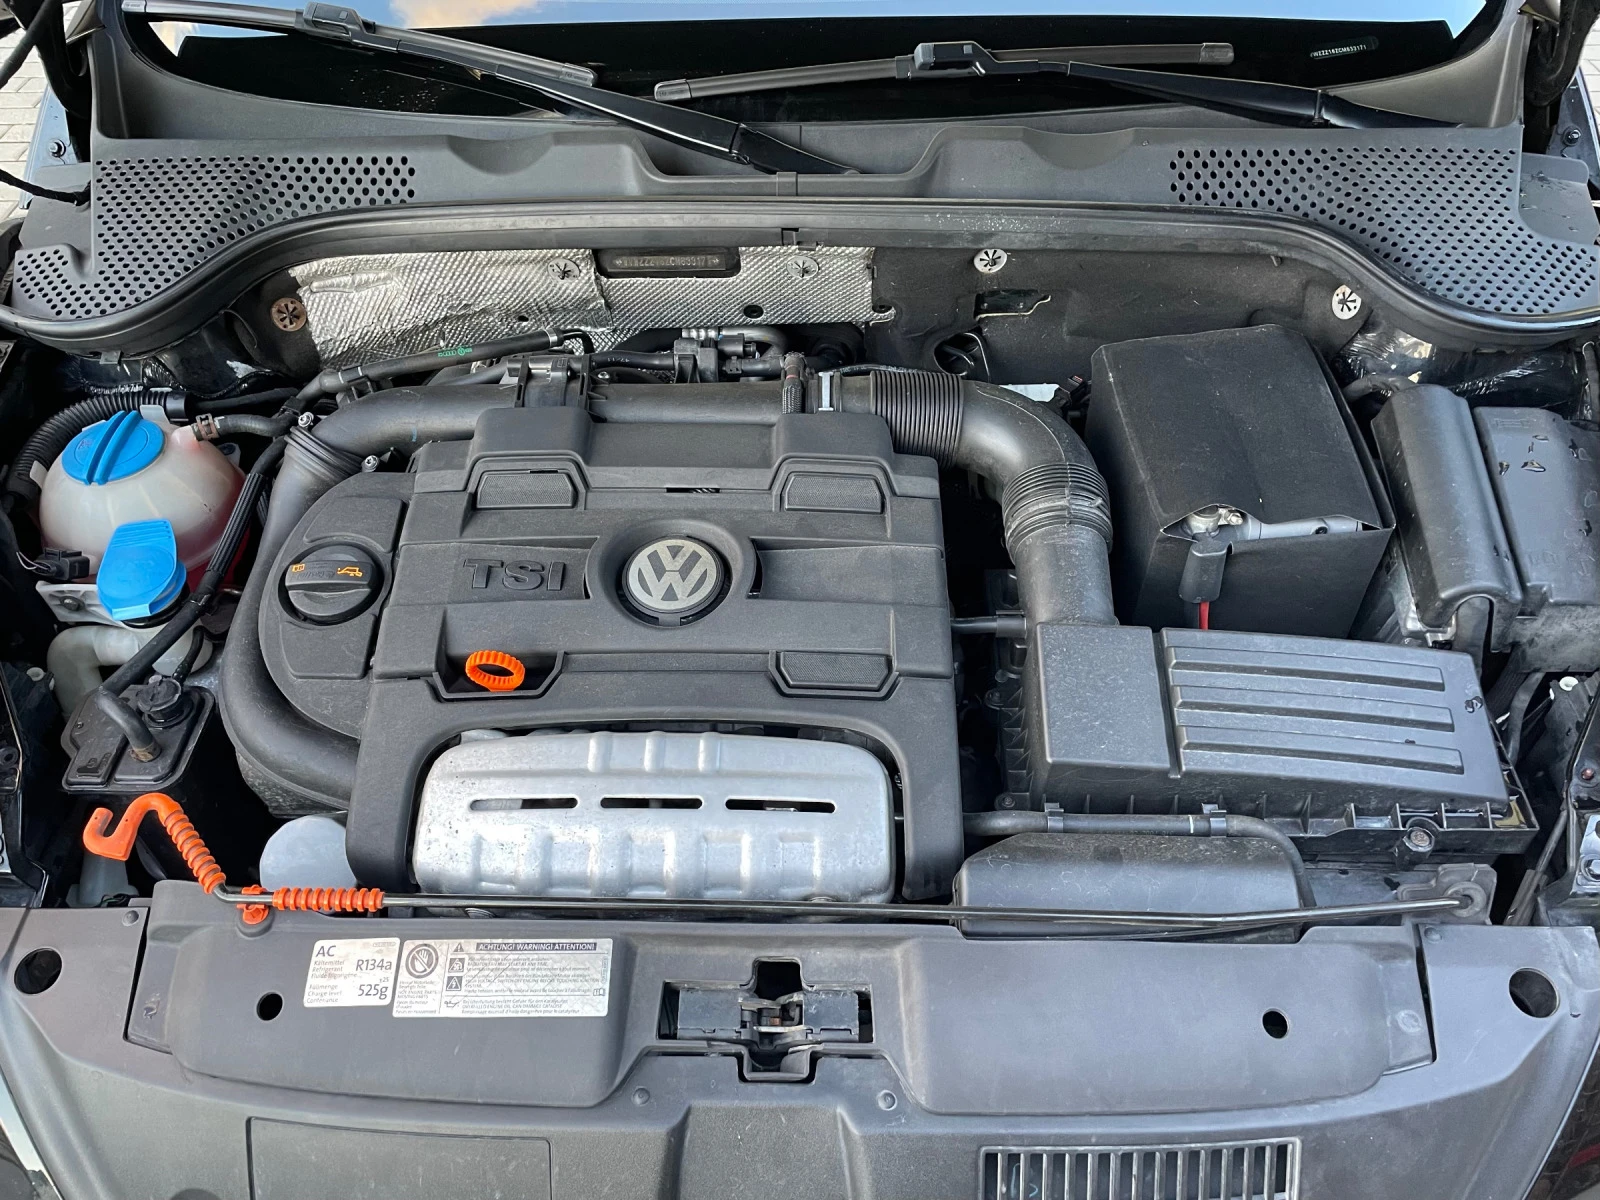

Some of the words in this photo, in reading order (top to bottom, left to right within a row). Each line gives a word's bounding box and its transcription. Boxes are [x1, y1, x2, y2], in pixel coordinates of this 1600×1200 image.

[464, 558, 567, 592] TSI
[631, 540, 716, 609] VW
[315, 945, 337, 957] AC
[479, 943, 515, 951] ACHTUNG!
[516, 943, 553, 951] WARNING!
[554, 943, 595, 951] ATTENTION!
[355, 958, 393, 971] R134a
[357, 983, 389, 1000] 525g
